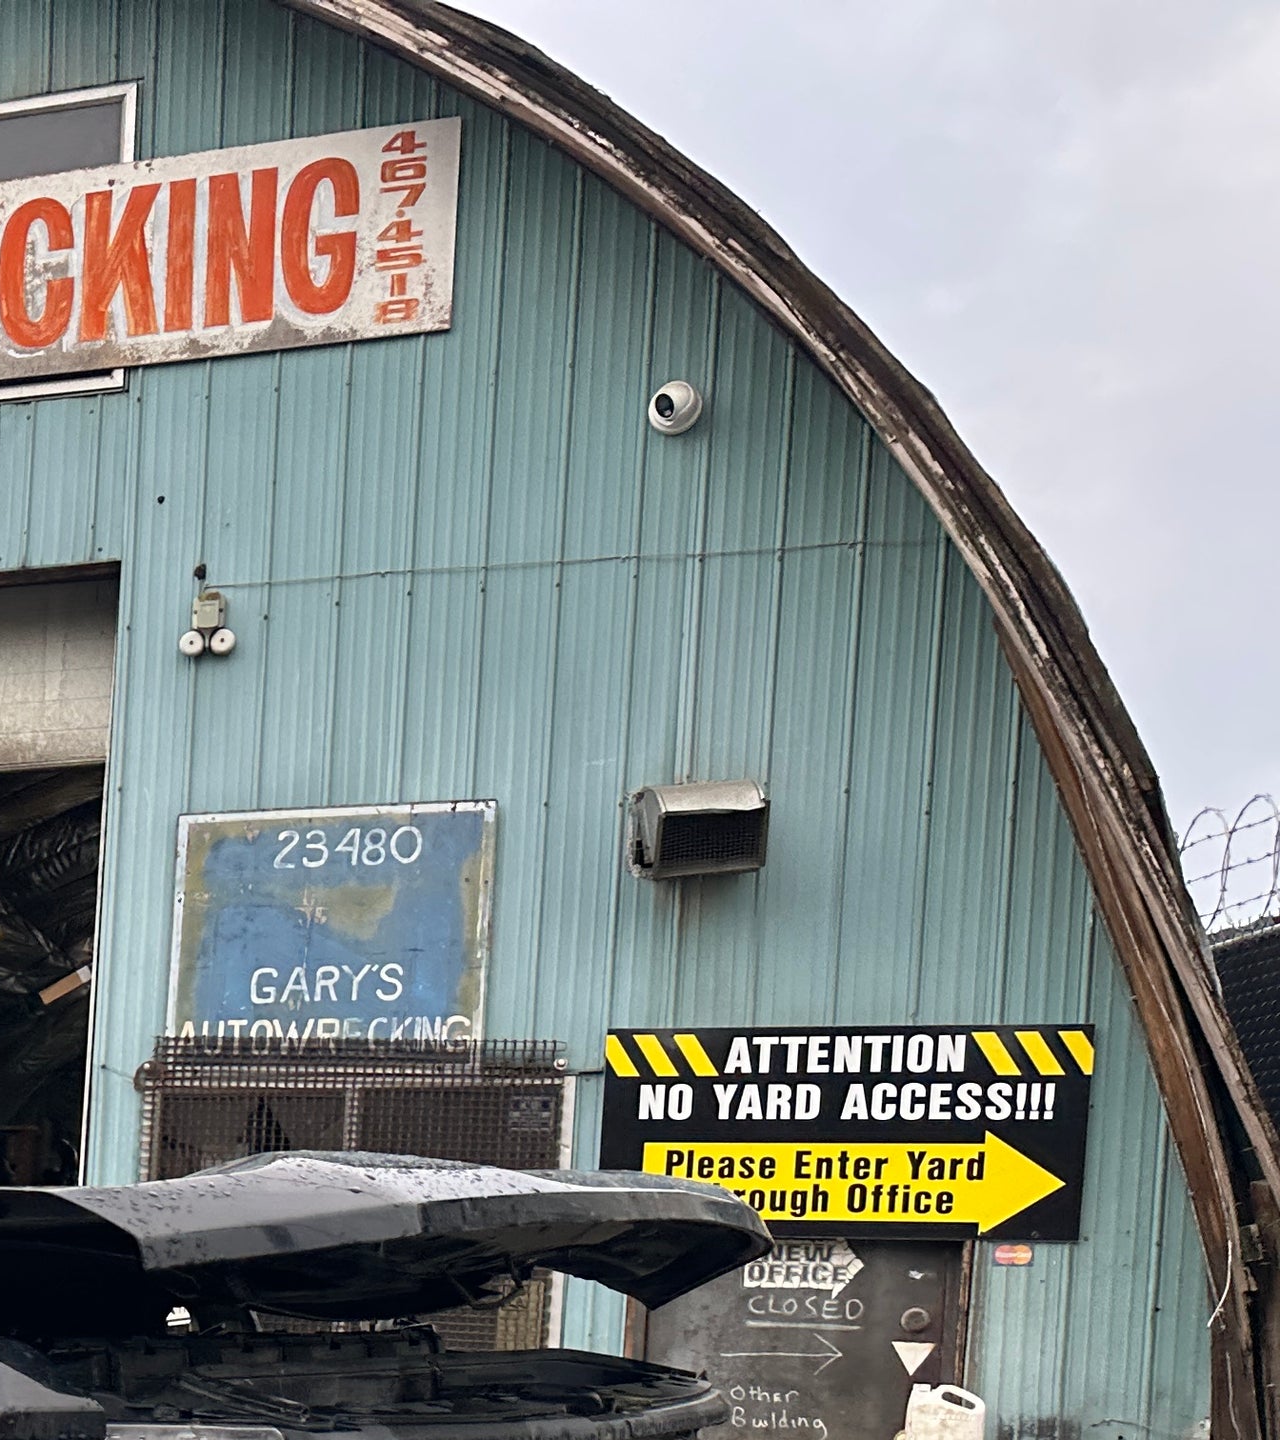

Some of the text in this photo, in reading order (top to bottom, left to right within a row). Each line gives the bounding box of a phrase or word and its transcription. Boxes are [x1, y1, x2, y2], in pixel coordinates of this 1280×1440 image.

[273, 825, 423, 869] 23480
[250, 963, 405, 1005] GARY'S
[723, 1034, 967, 1075] ATTENTION
[638, 1082, 1057, 1121] NO YARD ACCESS!!!
[665, 1149, 986, 1181] Please Enter Yard
[714, 1183, 954, 1218] ough Office
[769, 1243, 833, 1262] NEW
[747, 1263, 850, 1283] OFFICE
[747, 1294, 865, 1320] CLOSED
